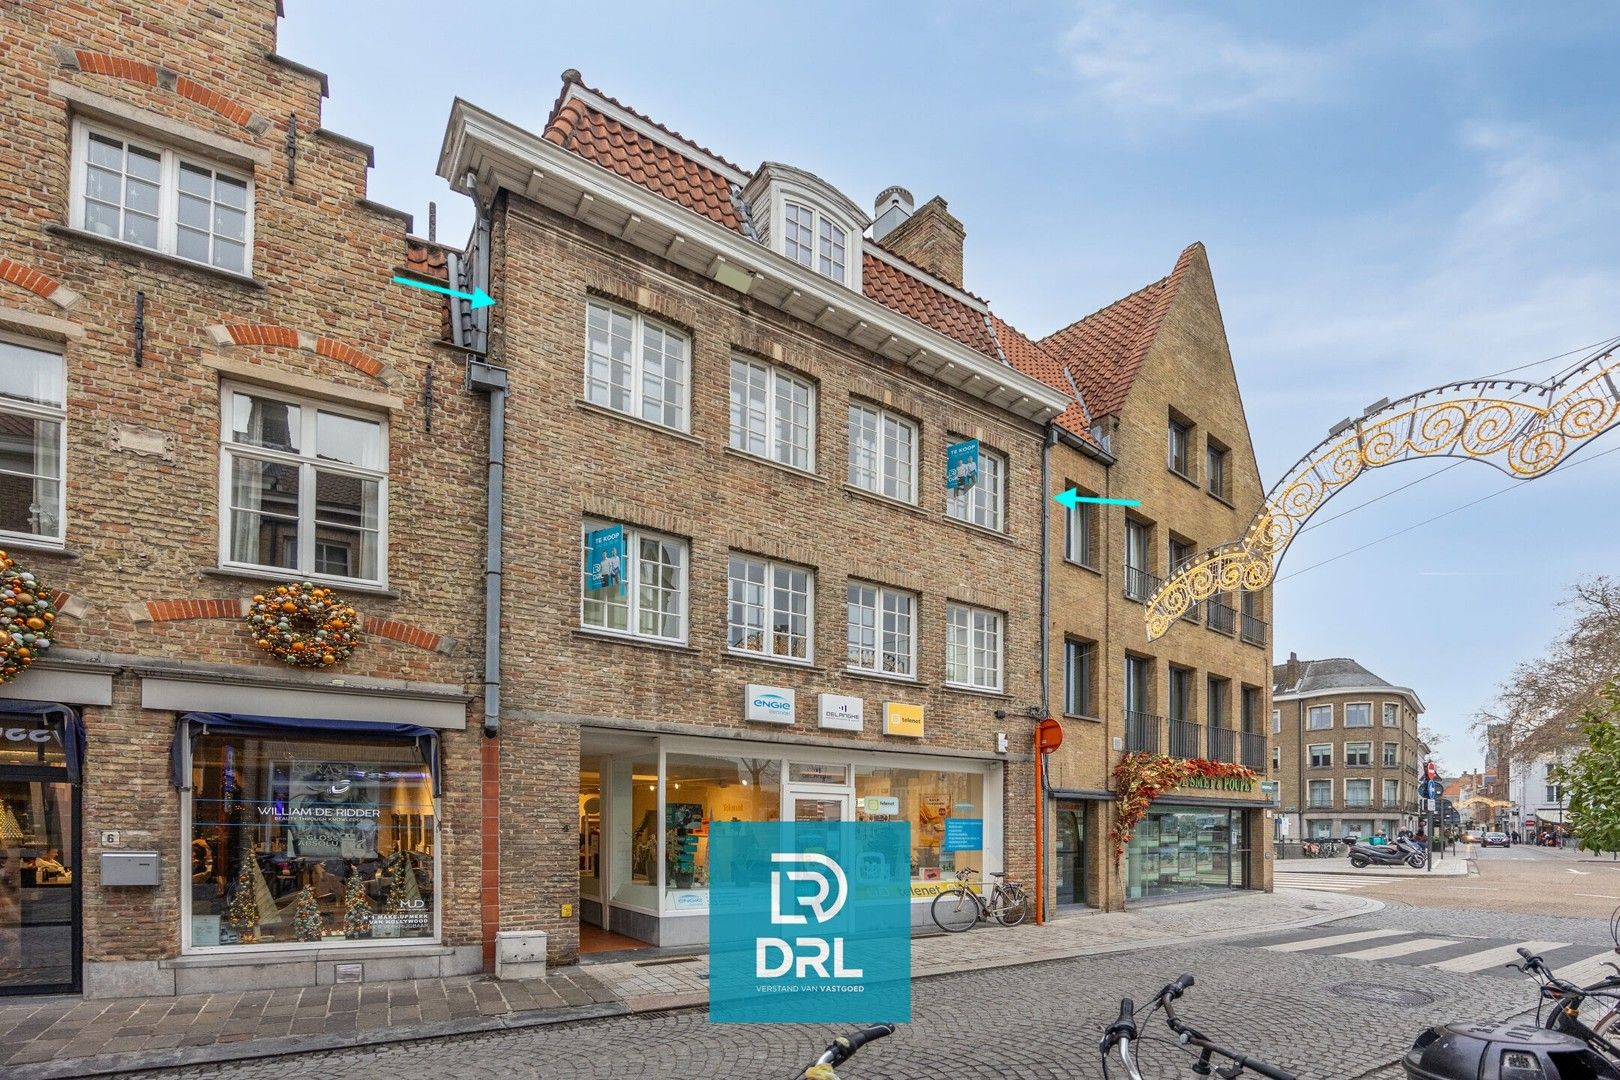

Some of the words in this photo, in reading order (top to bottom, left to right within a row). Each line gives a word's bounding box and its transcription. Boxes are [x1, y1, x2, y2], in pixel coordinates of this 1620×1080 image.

[257, 806, 313, 816] WILLIAM
[315, 807, 333, 817] DE
[336, 808, 381, 818] RIDDER
[107, 834, 115, 843] 6
[399, 899, 425, 908] MUD
